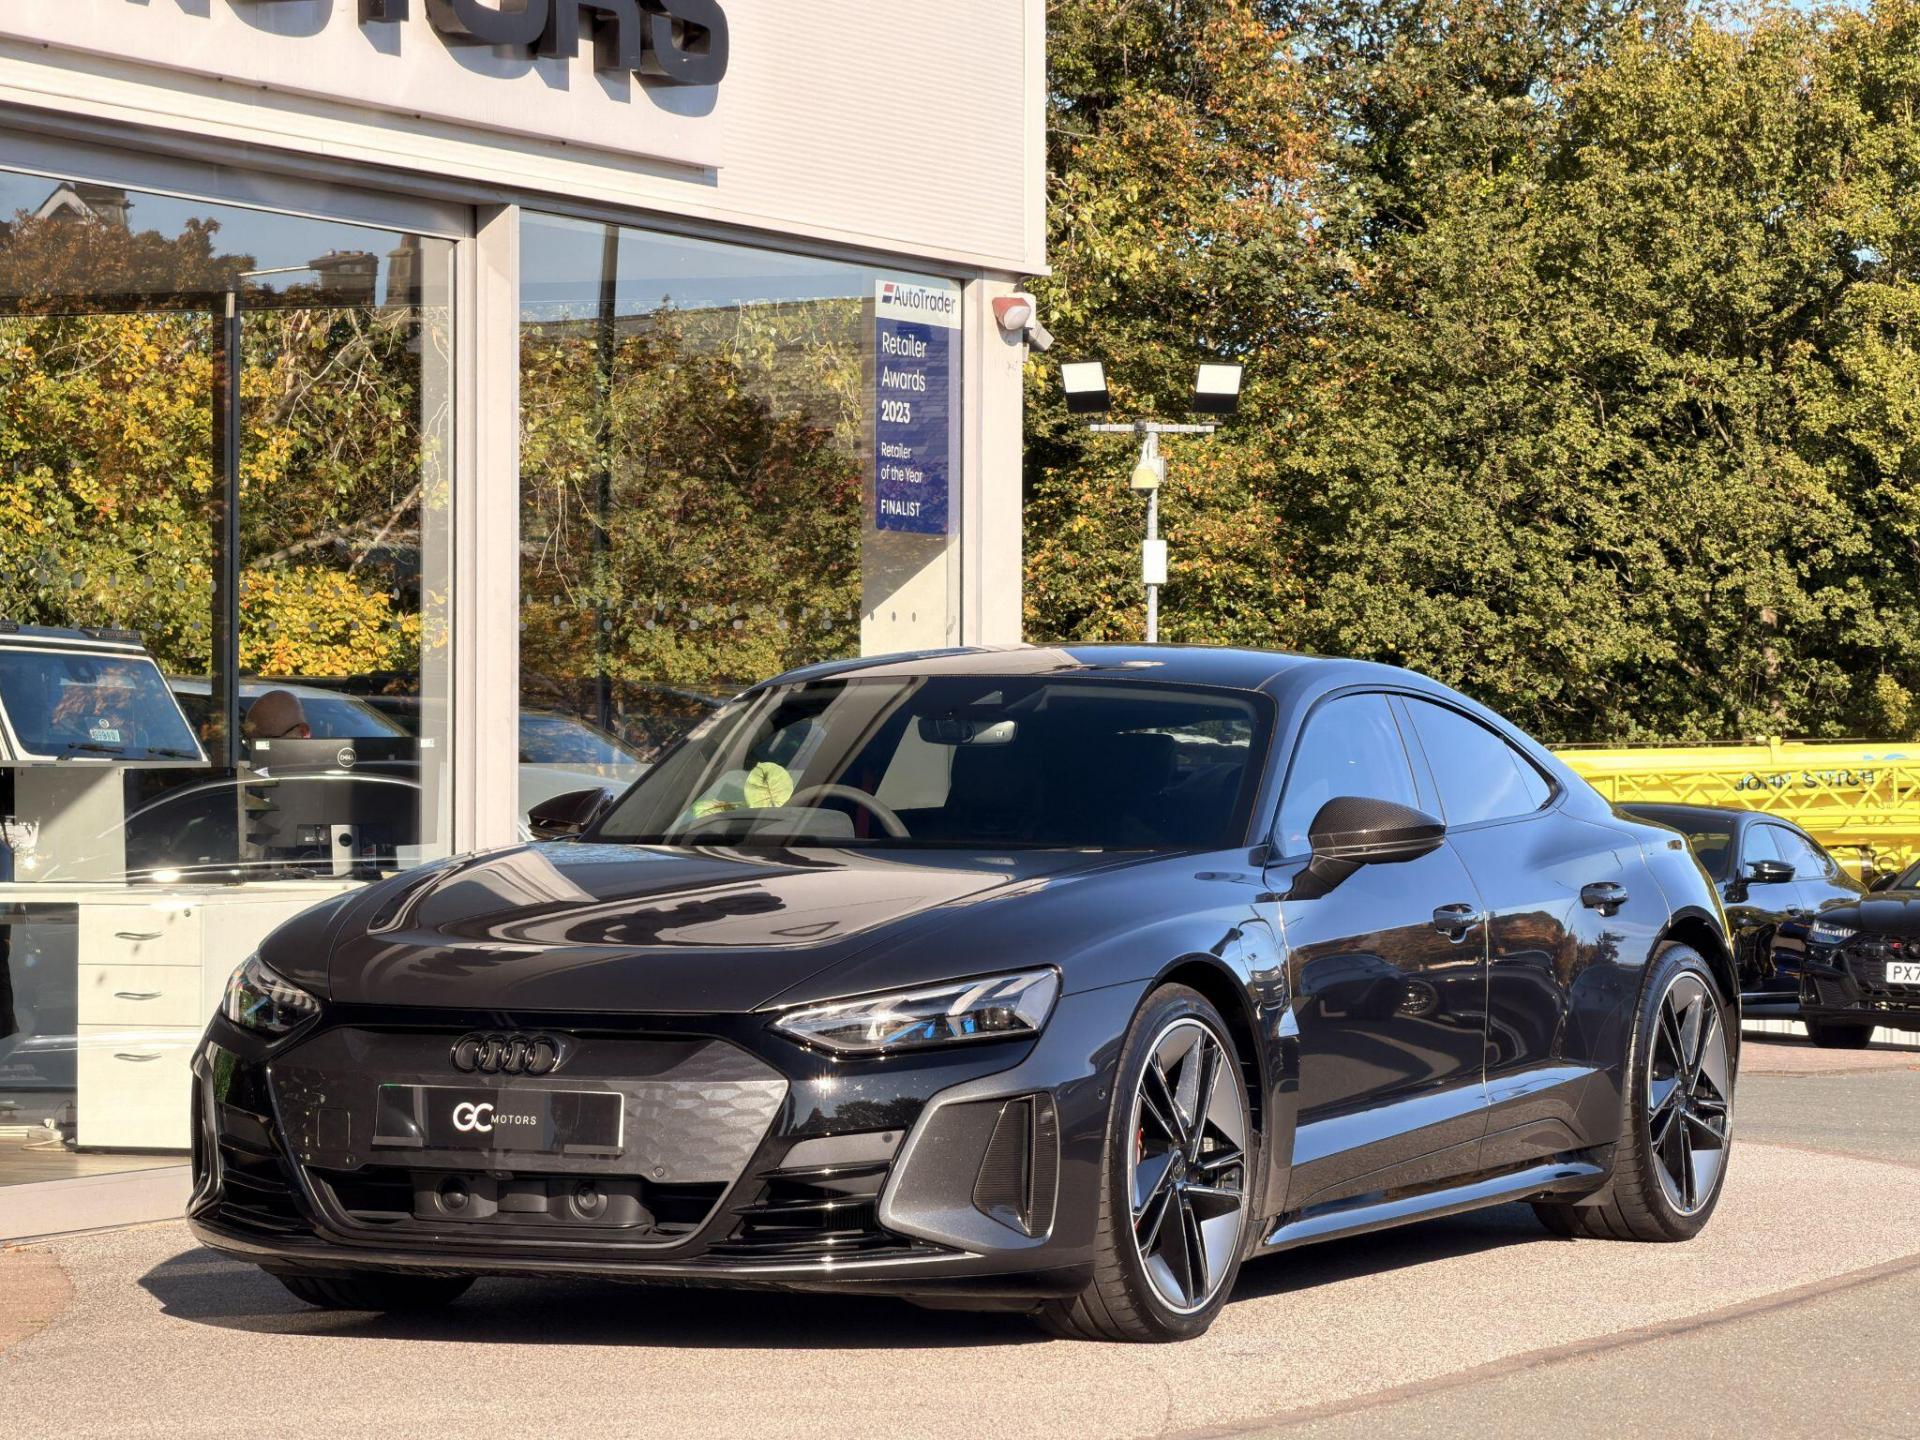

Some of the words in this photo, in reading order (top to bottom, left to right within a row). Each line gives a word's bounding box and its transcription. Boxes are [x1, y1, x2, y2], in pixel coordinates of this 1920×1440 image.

[893, 286, 956, 314] AutoTrader
[882, 332, 927, 358] Retailer
[881, 366, 926, 392] Awards
[881, 400, 911, 424] 2023
[881, 442, 911, 459] Retailer
[881, 464, 890, 480] of
[891, 466, 904, 482] the
[905, 467, 923, 483] Year
[881, 499, 921, 517] FINALIST
[452, 1102, 494, 1132] GC
[491, 1114, 537, 1126] MOTORS
